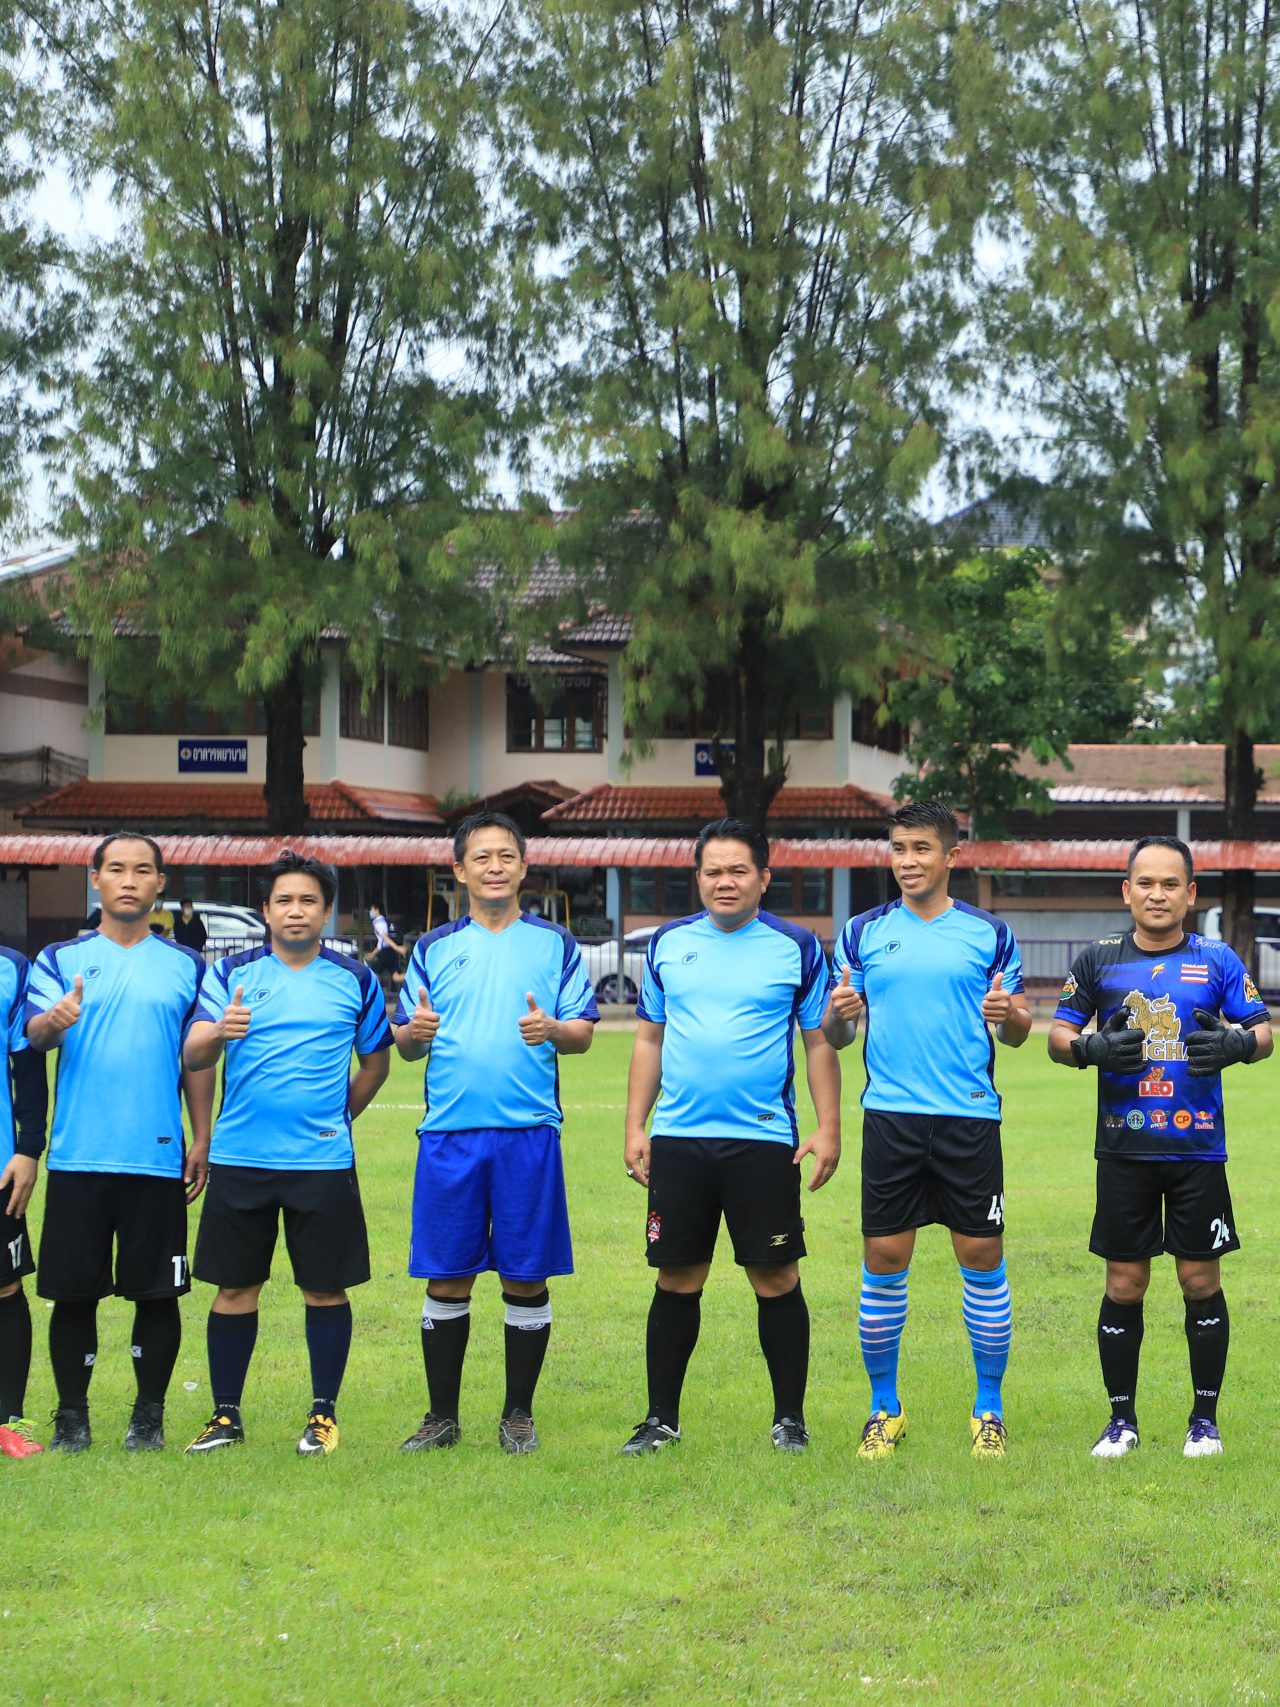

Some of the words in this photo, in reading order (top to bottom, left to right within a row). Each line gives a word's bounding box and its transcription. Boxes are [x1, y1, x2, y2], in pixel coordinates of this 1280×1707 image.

[193, 747, 247, 762] อาคารพยาบาล
[1140, 1082, 1174, 1096] LEO
[1175, 1115, 1190, 1123] CP
[1210, 1212, 1230, 1249] 24
[8, 1233, 23, 1270] 17
[1196, 1389, 1217, 1397] WISH
